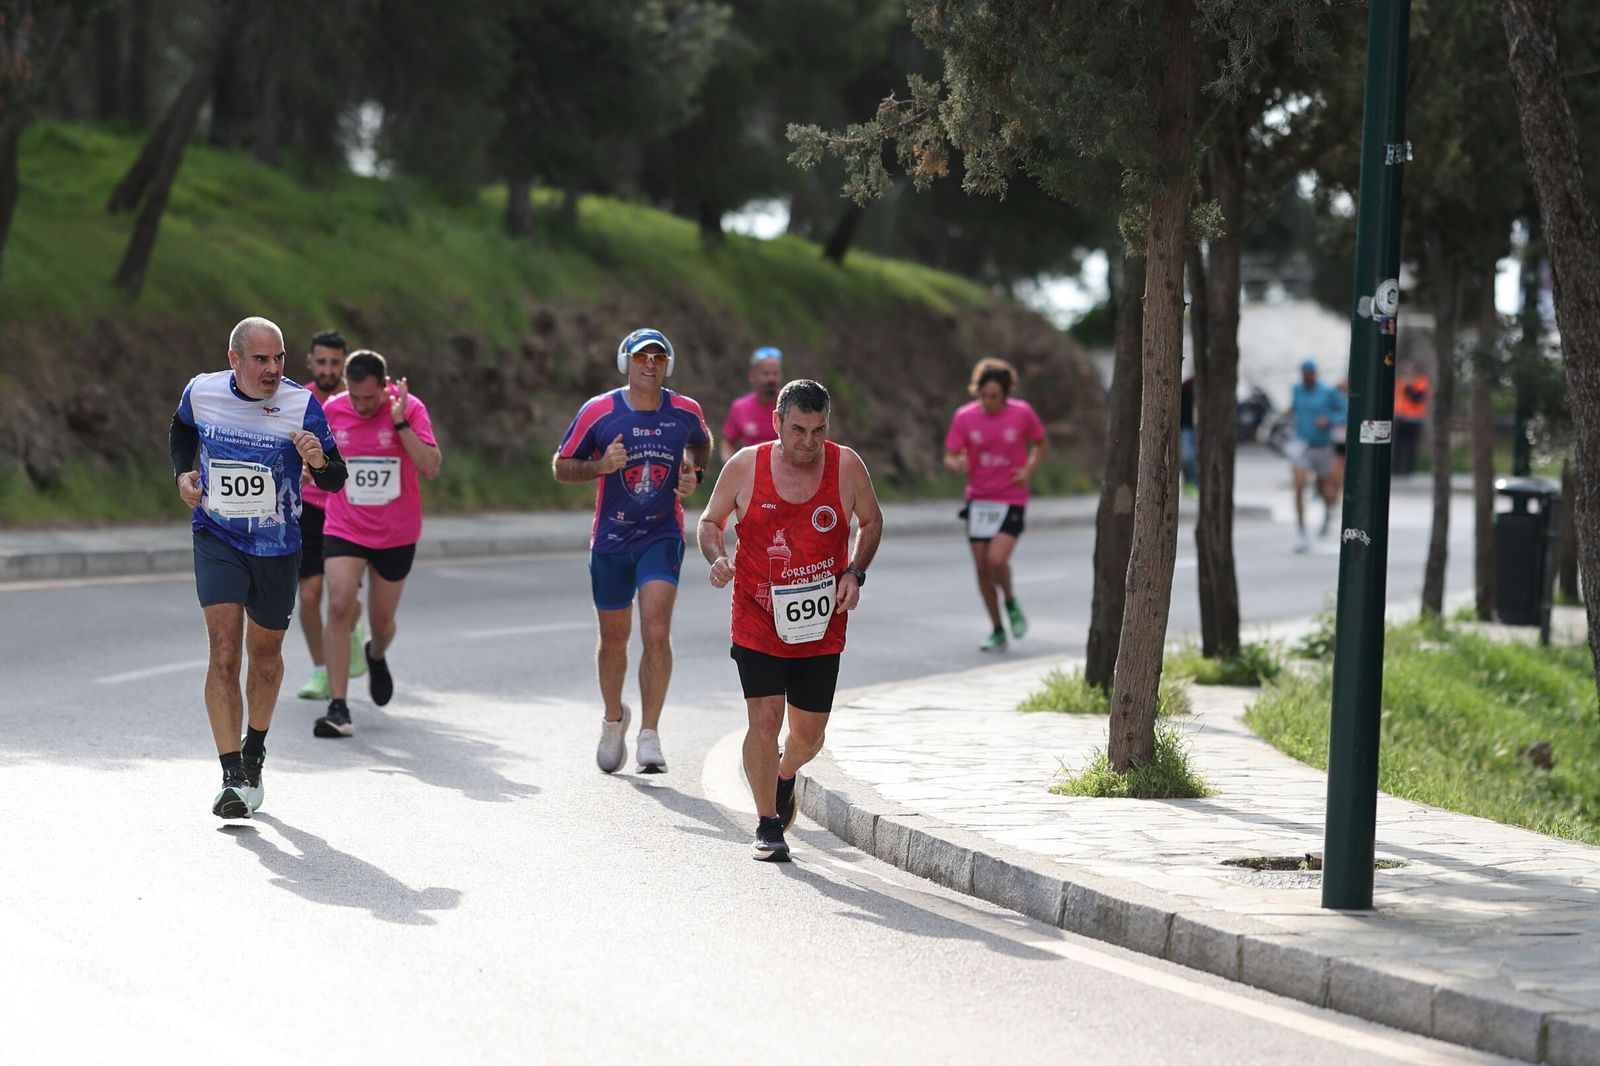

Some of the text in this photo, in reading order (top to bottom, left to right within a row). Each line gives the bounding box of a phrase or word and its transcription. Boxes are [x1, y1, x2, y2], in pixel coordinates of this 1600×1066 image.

[204, 424, 216, 439] 31
[216, 426, 275, 442] TotalEnergies
[224, 436, 250, 446] MARATÓN
[220, 475, 265, 497] 509
[355, 470, 391, 487] 697
[781, 556, 835, 579] CORREDORES
[791, 570, 833, 585] CON MIGA
[786, 595, 830, 622] 690
